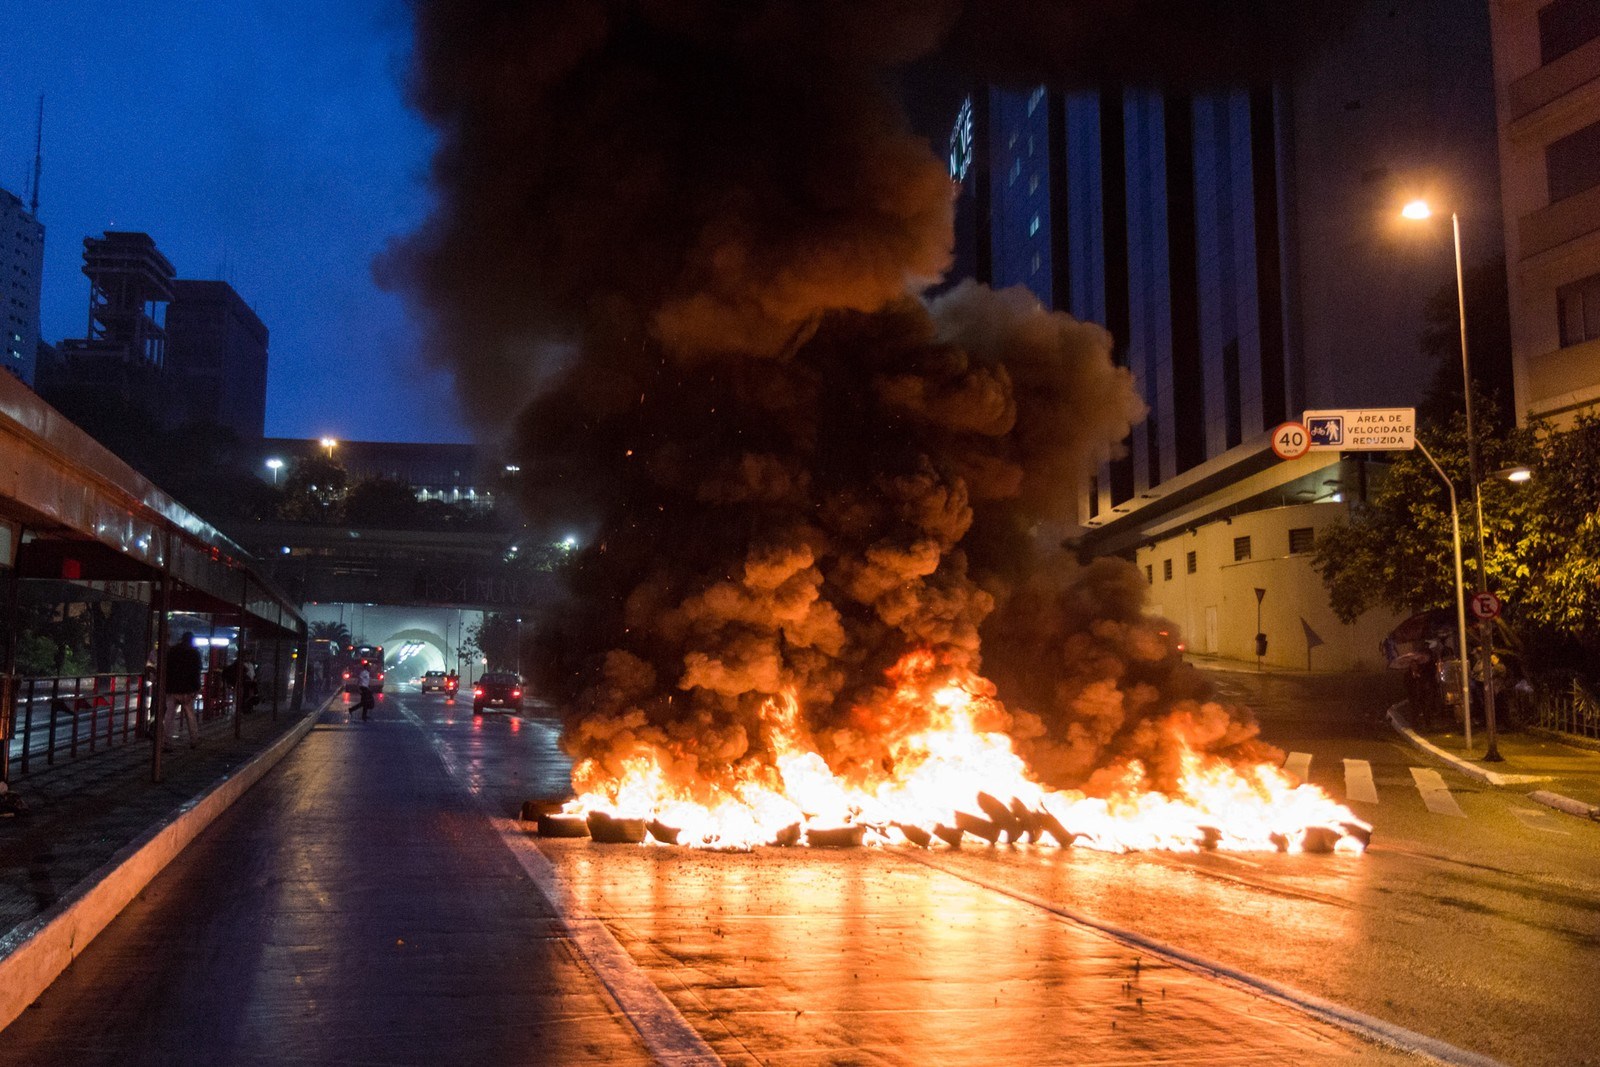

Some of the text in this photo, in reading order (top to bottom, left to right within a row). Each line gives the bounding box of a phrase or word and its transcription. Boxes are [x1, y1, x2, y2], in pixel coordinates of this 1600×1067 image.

[1357, 411, 1402, 423] ÁREA DE
[1347, 425, 1412, 434] VELOCIDADE
[1279, 432, 1303, 447] 40
[1352, 436, 1405, 445] REDUZIDA
[1480, 597, 1491, 614] E
